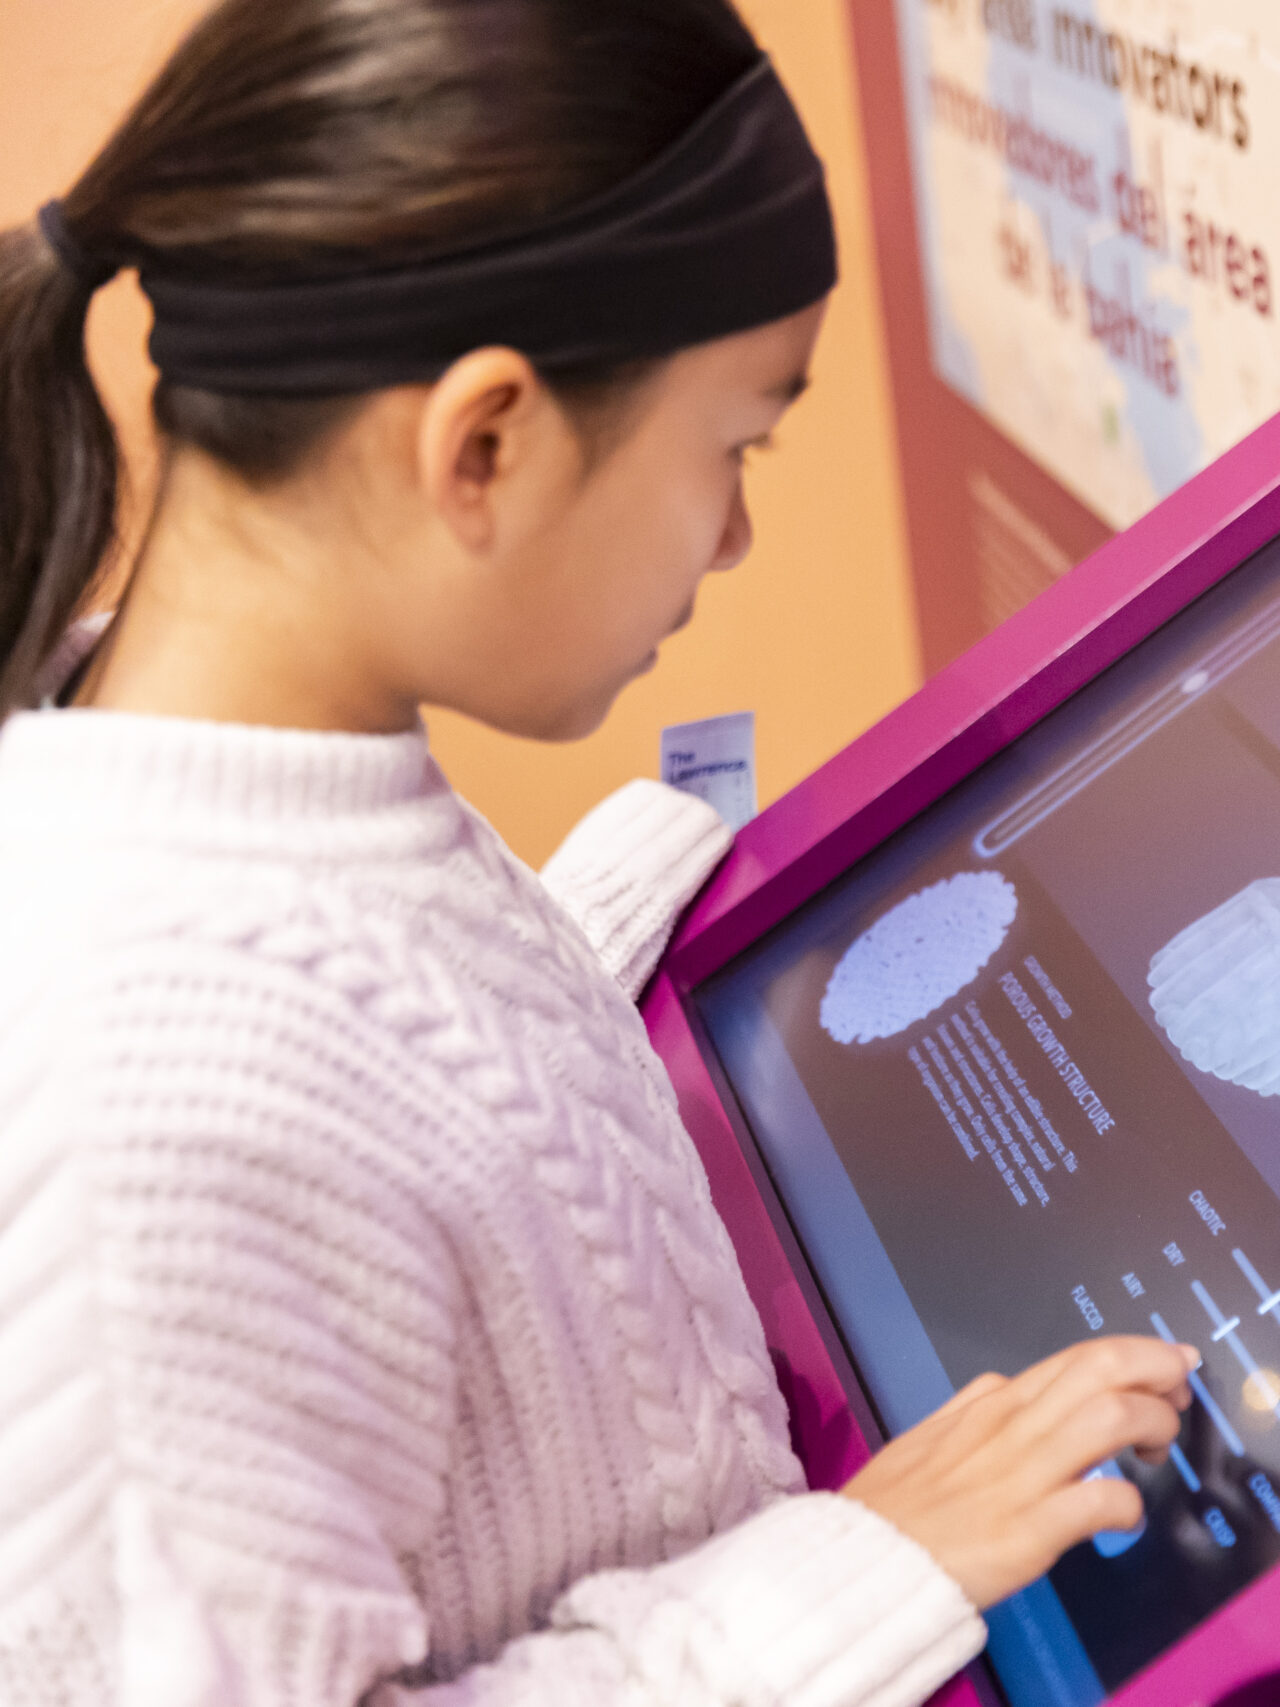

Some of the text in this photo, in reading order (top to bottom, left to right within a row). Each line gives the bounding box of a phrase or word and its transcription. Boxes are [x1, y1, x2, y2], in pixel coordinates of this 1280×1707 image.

[999, 971, 1115, 1136] POROUS GROWTH STRUCTURE
[951, 1122, 979, 1161] combined.
[970, 1114, 986, 1135] Only
[980, 1133, 996, 1153] cells
[990, 1149, 1007, 1172] from
[1002, 1168, 1015, 1186] the
[1009, 1182, 1028, 1206] same
[979, 1093, 996, 1116] Cells
[990, 1113, 1013, 1144] develop
[1008, 1141, 1026, 1168] shape,
[1020, 1163, 1050, 1206] structure,
[1010, 1109, 1035, 1143] complex,
[1029, 1141, 1056, 1171] natural
[1037, 1116, 1065, 1155] structure.
[1060, 1150, 1078, 1173] This
[1189, 1189, 1226, 1236] CHAOTIC
[1162, 1241, 1185, 1267] DRY
[1071, 1285, 1104, 1330] FLACCID
[1121, 1272, 1146, 1299] AIRY
